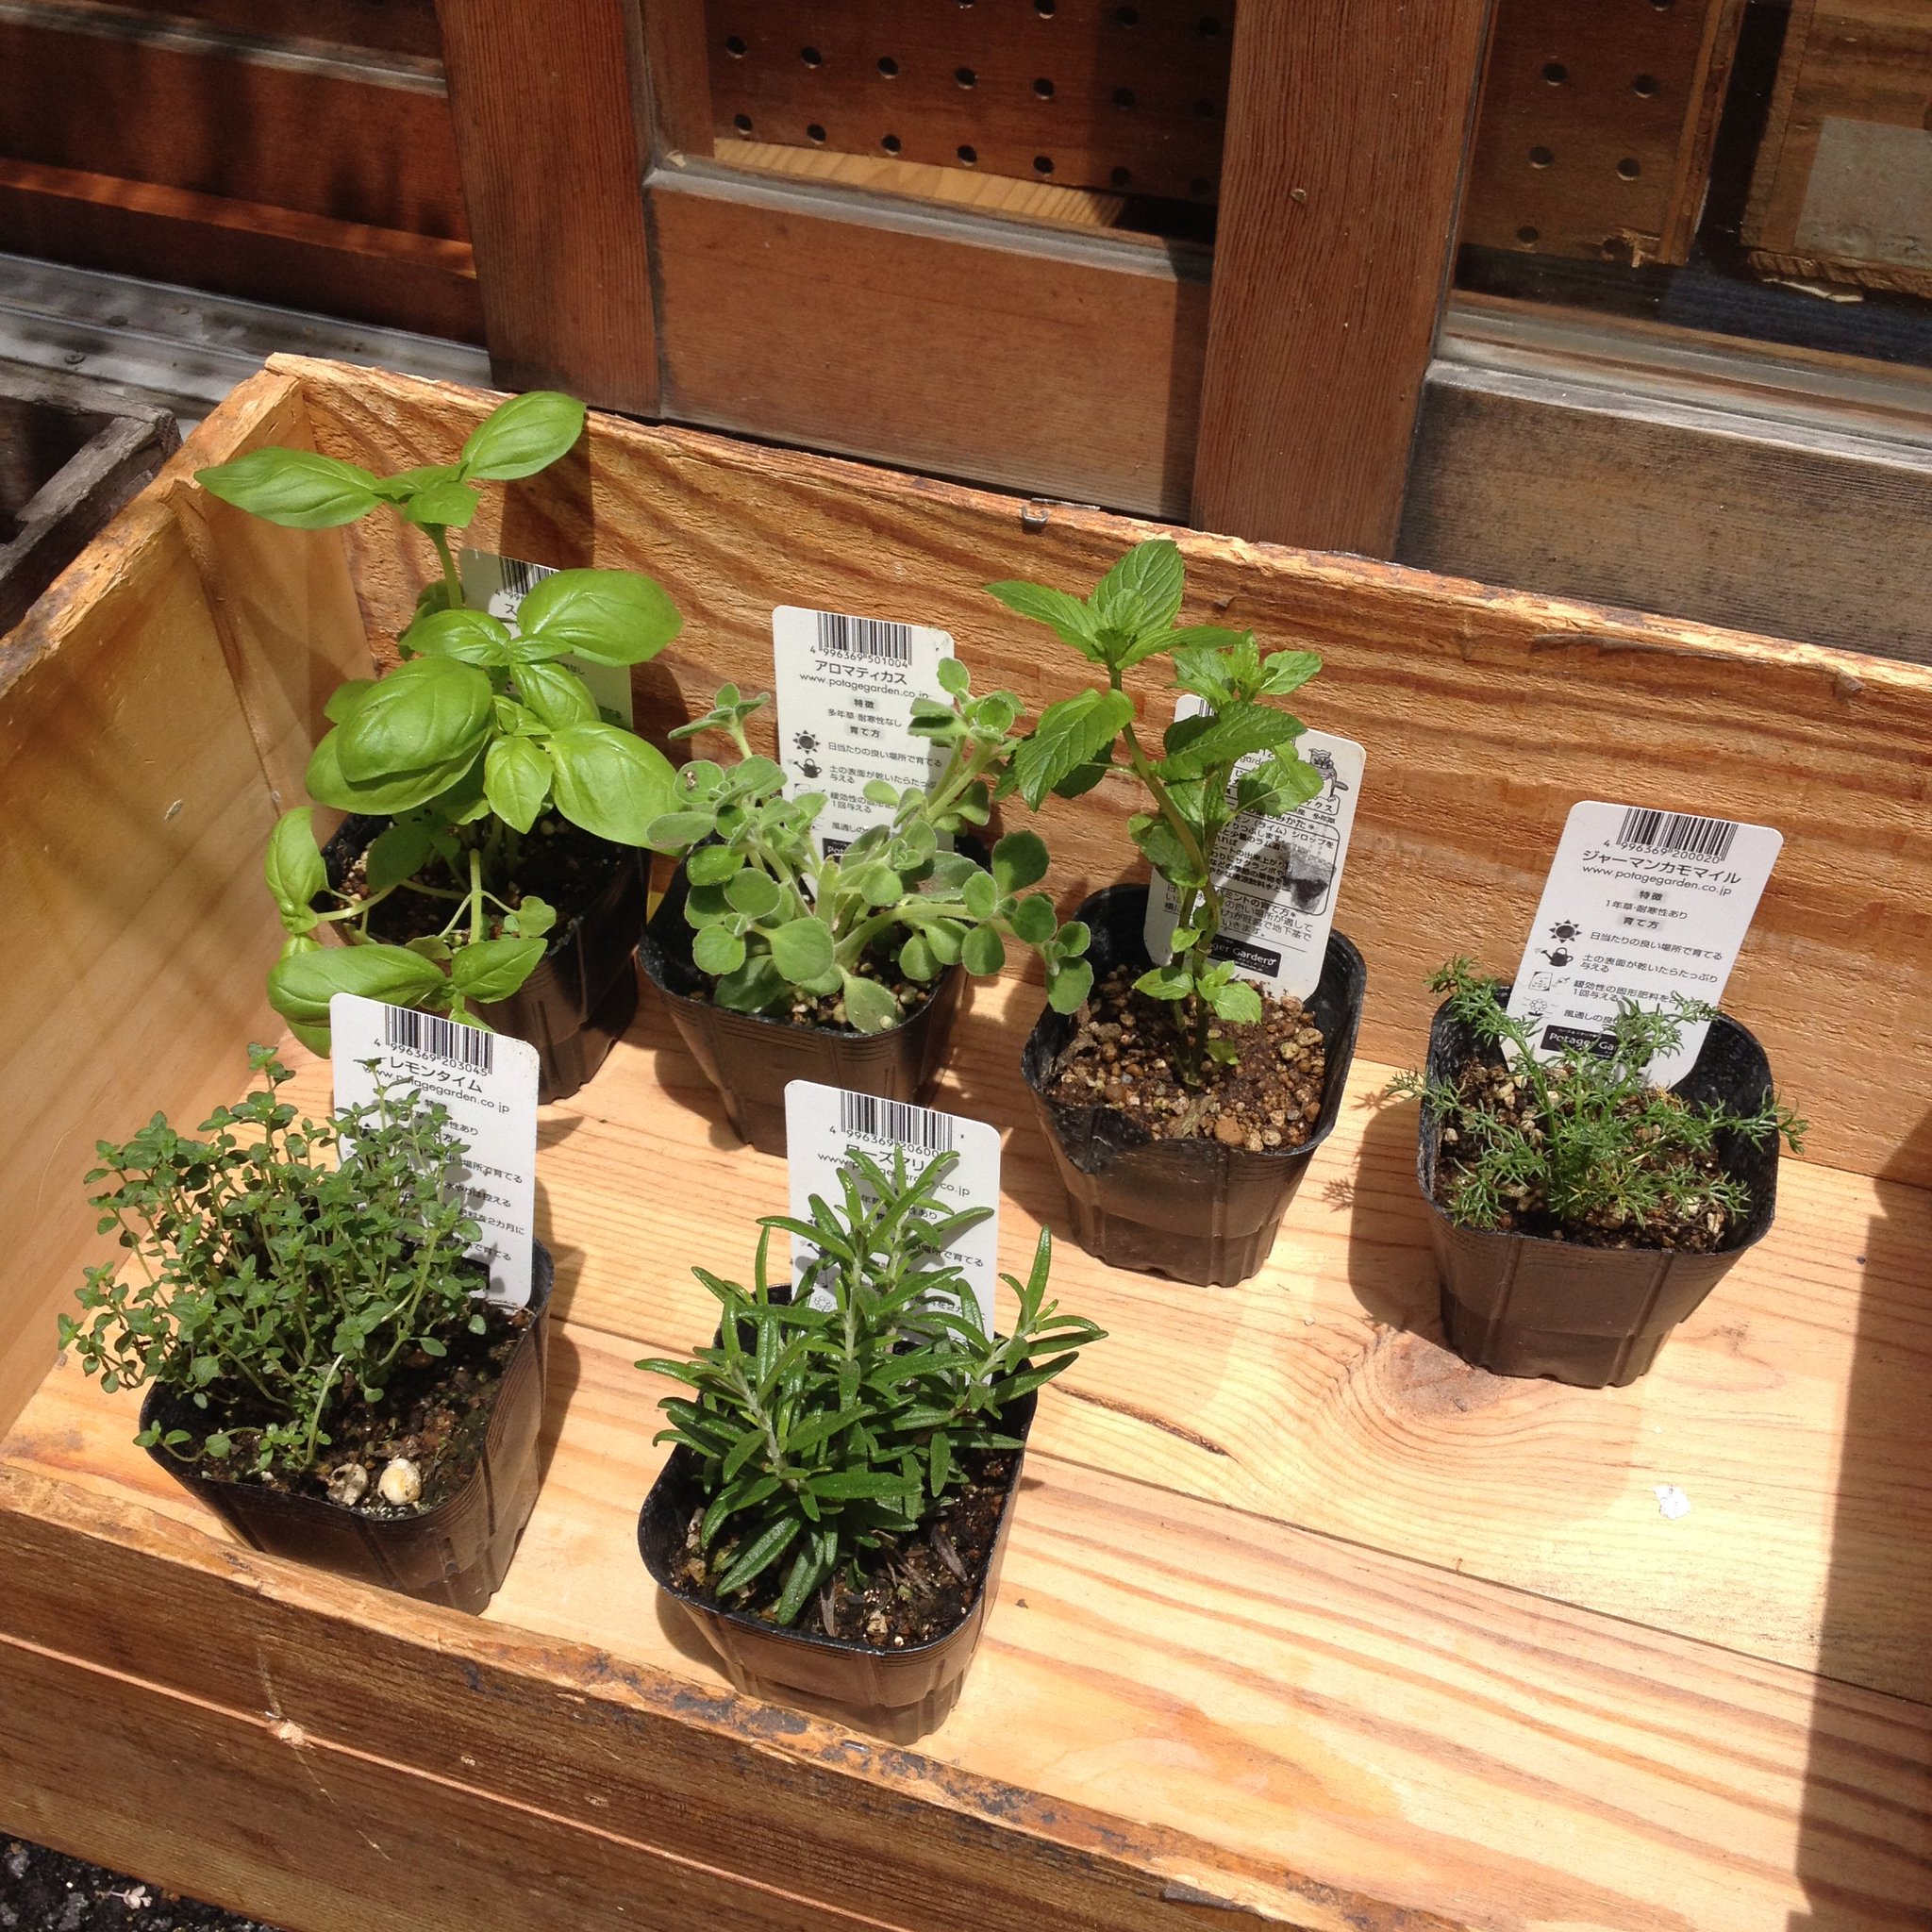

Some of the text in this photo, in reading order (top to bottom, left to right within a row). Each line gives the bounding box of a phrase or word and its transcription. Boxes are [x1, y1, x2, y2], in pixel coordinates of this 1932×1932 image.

[809, 646, 908, 669] 4 996369 501004
[815, 659, 908, 685] アロマティカス
[849, 725, 880, 739] 育て方
[829, 765, 938, 790] 土の表面が乾いたらたっぷ
[829, 774, 855, 785] 与える
[1603, 839, 1722, 864] 4 996369 200020
[1581, 848, 1742, 885] ジャーマンカモマイル
[1582, 863, 1733, 897] www.potagegarden.co.jp
[1623, 916, 1660, 929] 育て方
[1233, 945, 1273, 964] Garden
[1591, 931, 1724, 960] 日当たりの良い場所で育てる
[1580, 962, 1609, 974] 与える
[1582, 953, 1719, 984] 土の表面が乾いたらたっぷり
[1549, 1032, 1592, 1052] Potage
[374, 1039, 489, 1077] 4 996369 203045
[389, 1057, 483, 1093] レモンタイム
[829, 1125, 940, 1158] 4 996369 20600
